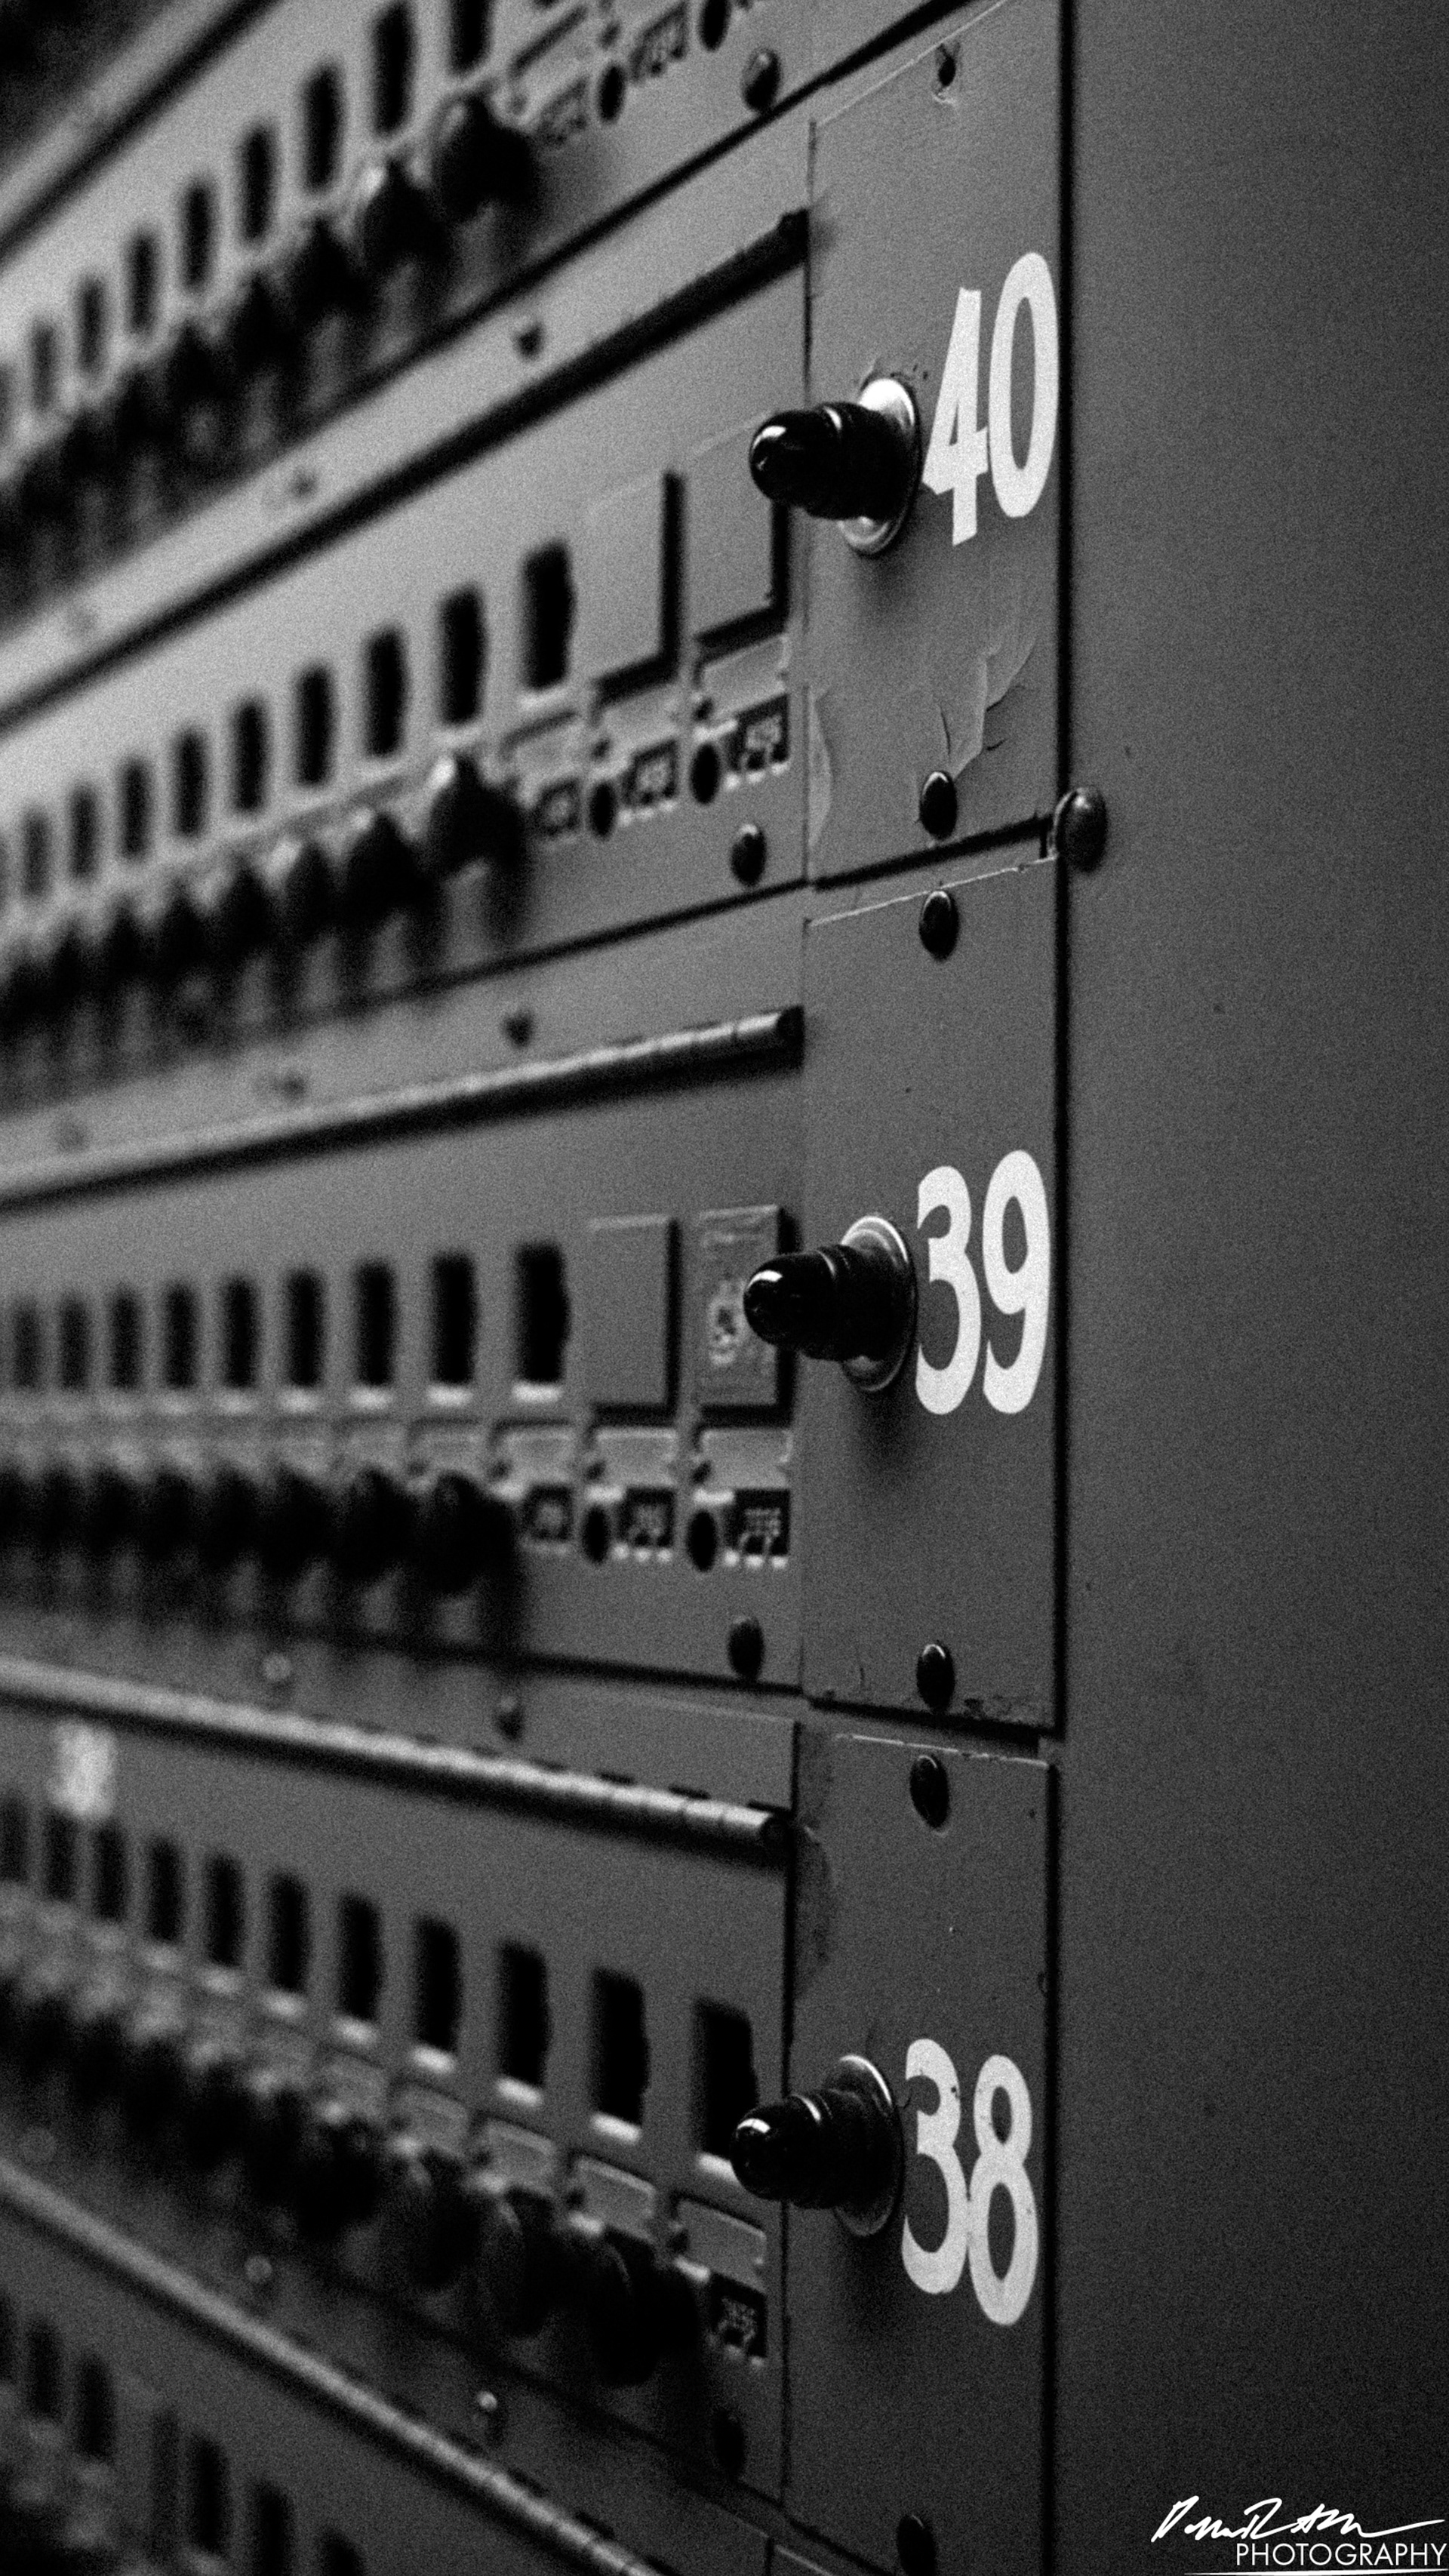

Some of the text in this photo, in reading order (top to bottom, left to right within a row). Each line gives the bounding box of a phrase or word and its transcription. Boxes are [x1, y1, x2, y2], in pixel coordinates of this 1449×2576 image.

[922, 252, 1059, 547] 40
[915, 1150, 1051, 1414] 39
[901, 2038, 1038, 2325] 38
